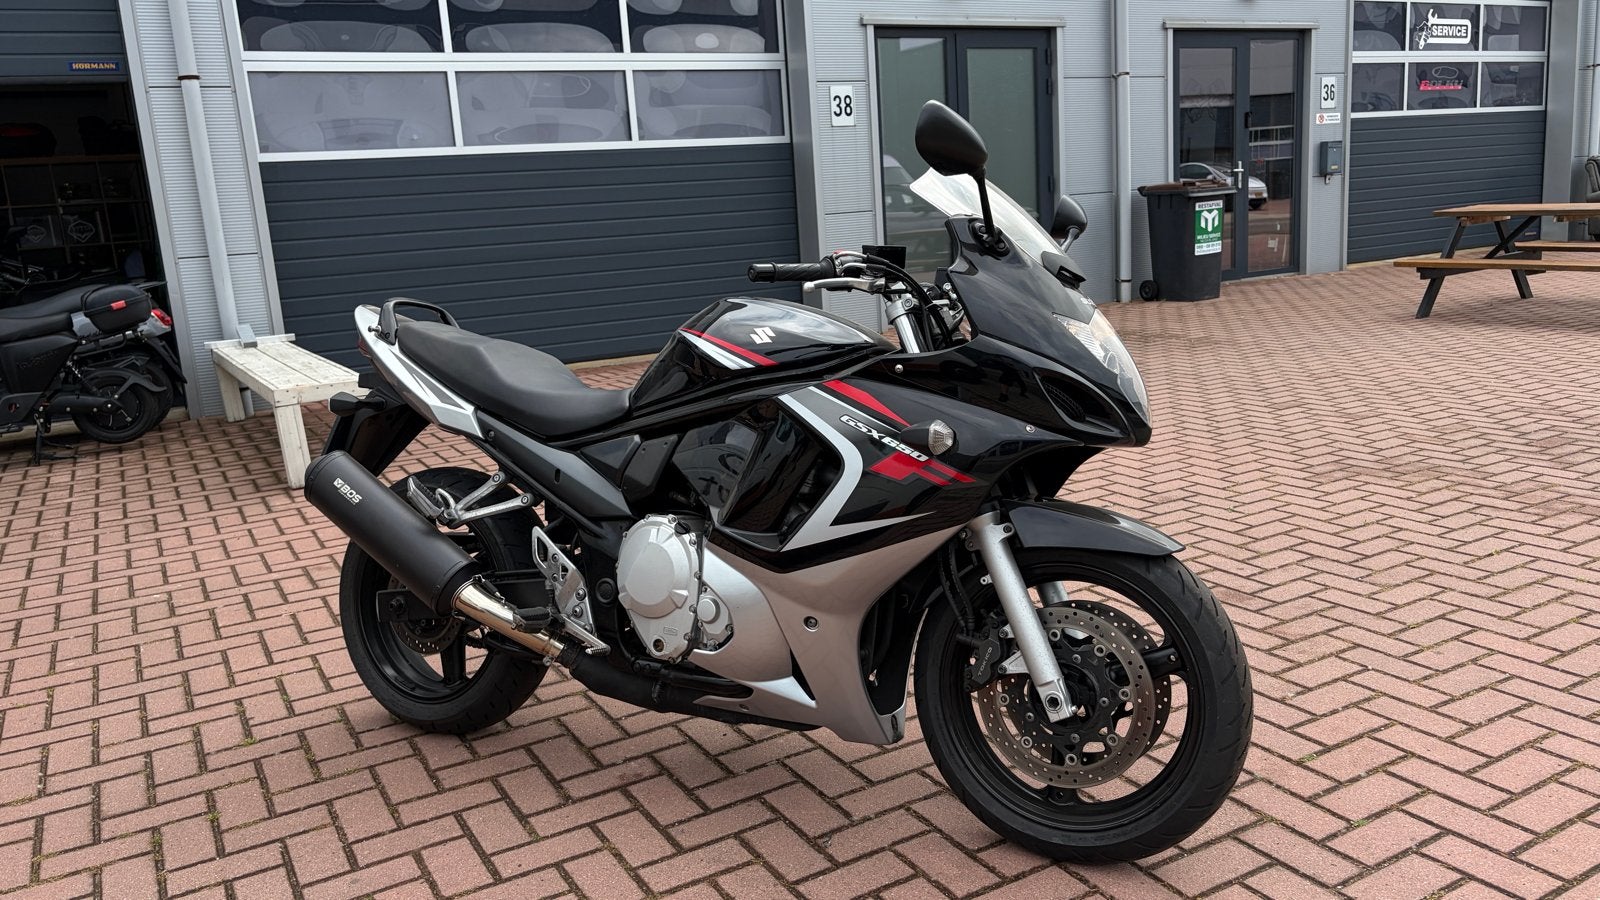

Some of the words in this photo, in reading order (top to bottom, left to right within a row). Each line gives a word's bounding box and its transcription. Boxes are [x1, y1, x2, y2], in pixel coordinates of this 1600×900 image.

[1431, 25, 1467, 37] SERVICE
[1322, 84, 1335, 101] 36
[833, 94, 853, 117] 38
[977, 646, 993, 677] TOKICO
